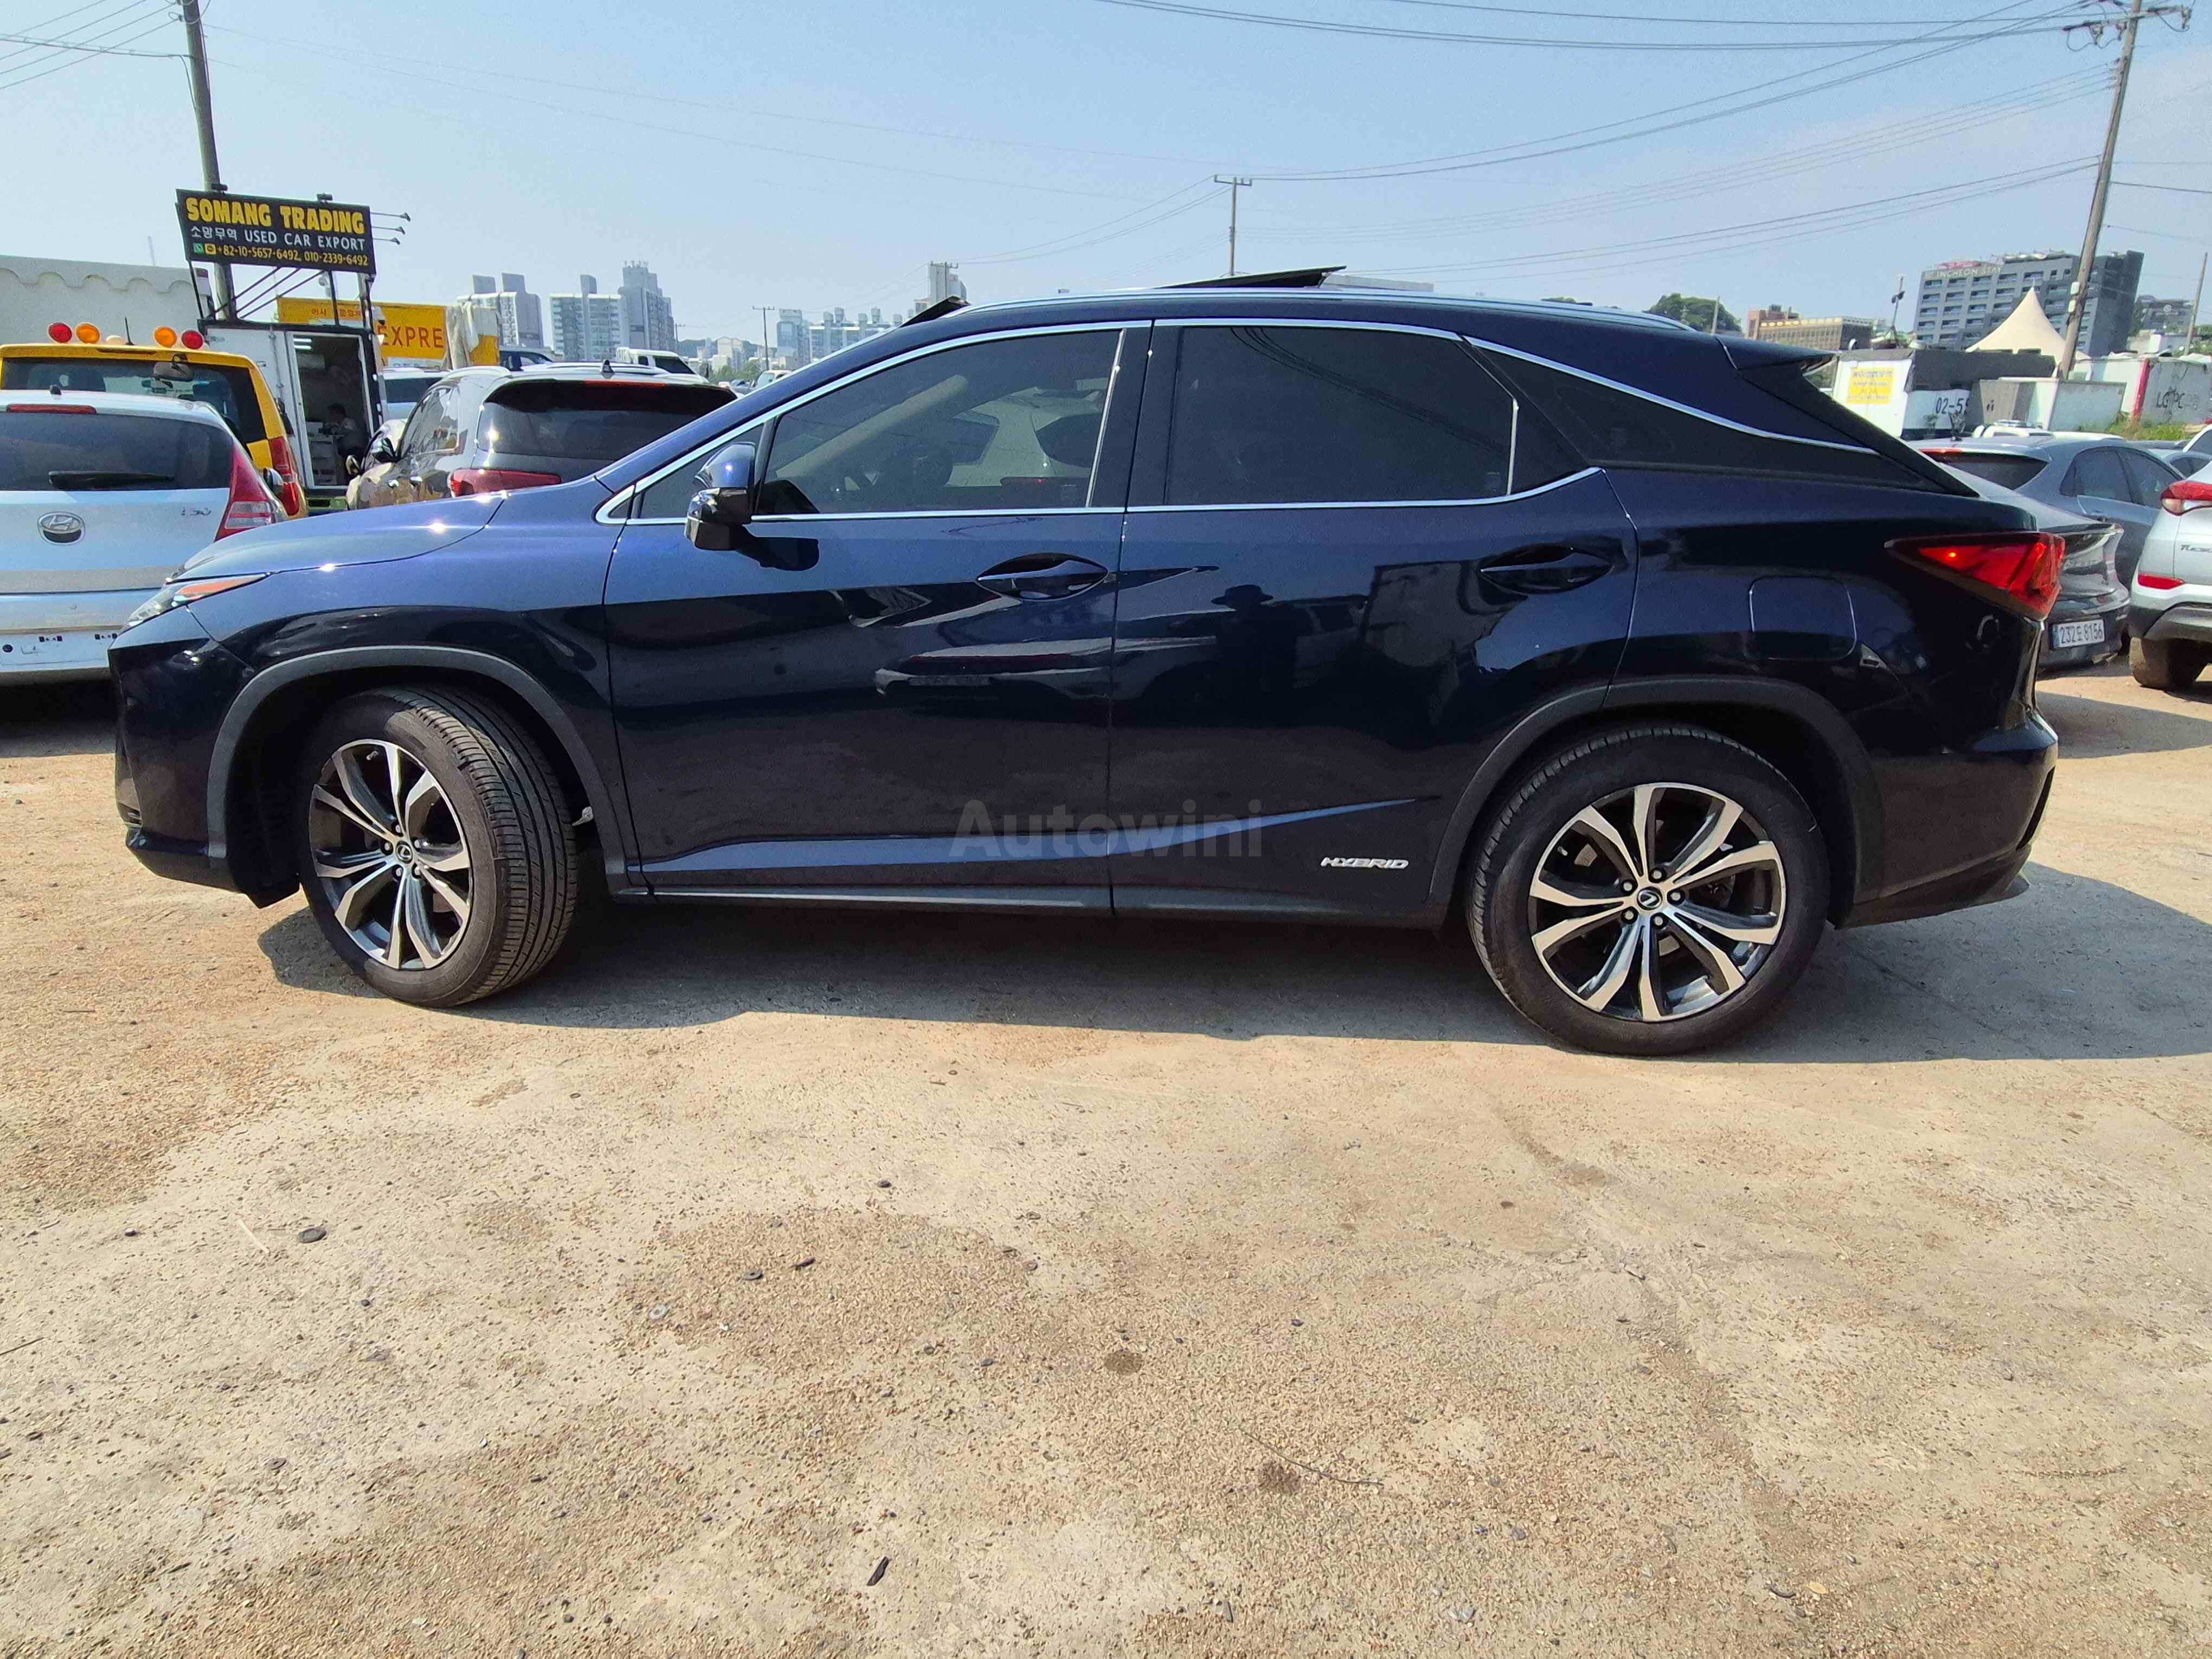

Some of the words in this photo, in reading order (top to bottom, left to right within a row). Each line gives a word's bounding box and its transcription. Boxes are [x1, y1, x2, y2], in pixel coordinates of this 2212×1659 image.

[186, 197, 271, 227] SOMANG
[280, 205, 365, 234] TRADING
[191, 226, 237, 241] 소망무역
[245, 230, 277, 243] USED
[284, 233, 311, 247] CAR
[318, 235, 365, 250] EXPORT
[304, 251, 368, 266] 010-2339-6492
[1320, 857, 1409, 869] HYBRID
